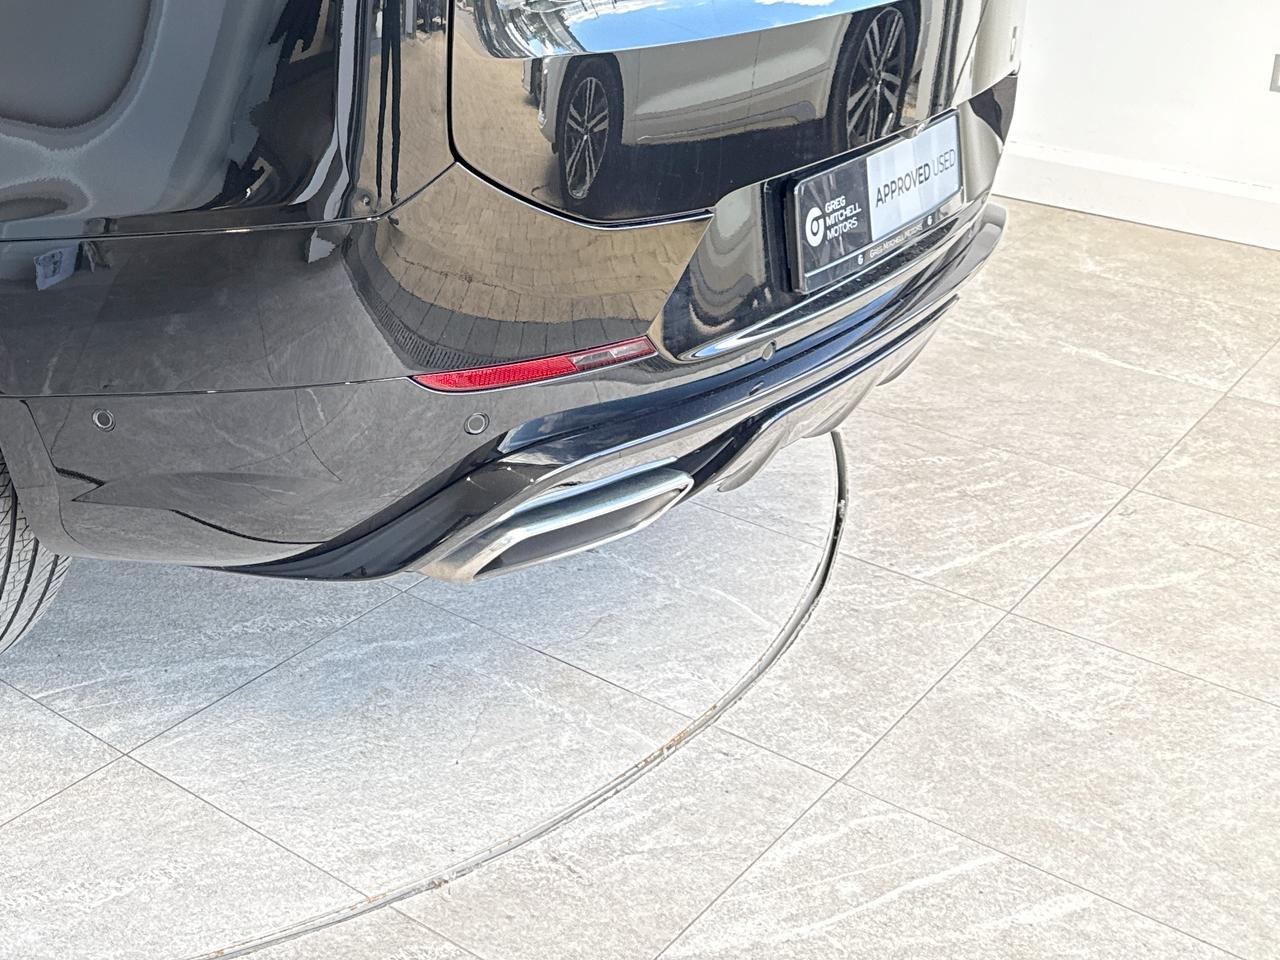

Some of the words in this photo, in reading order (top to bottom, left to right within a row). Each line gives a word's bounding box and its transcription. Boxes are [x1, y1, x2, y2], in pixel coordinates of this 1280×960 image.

[875, 162, 931, 209] APPROVED
[932, 148, 956, 177] USED
[825, 195, 846, 213] GREG
[826, 202, 862, 227] MITCHELL
[826, 218, 858, 240] MOTORS
